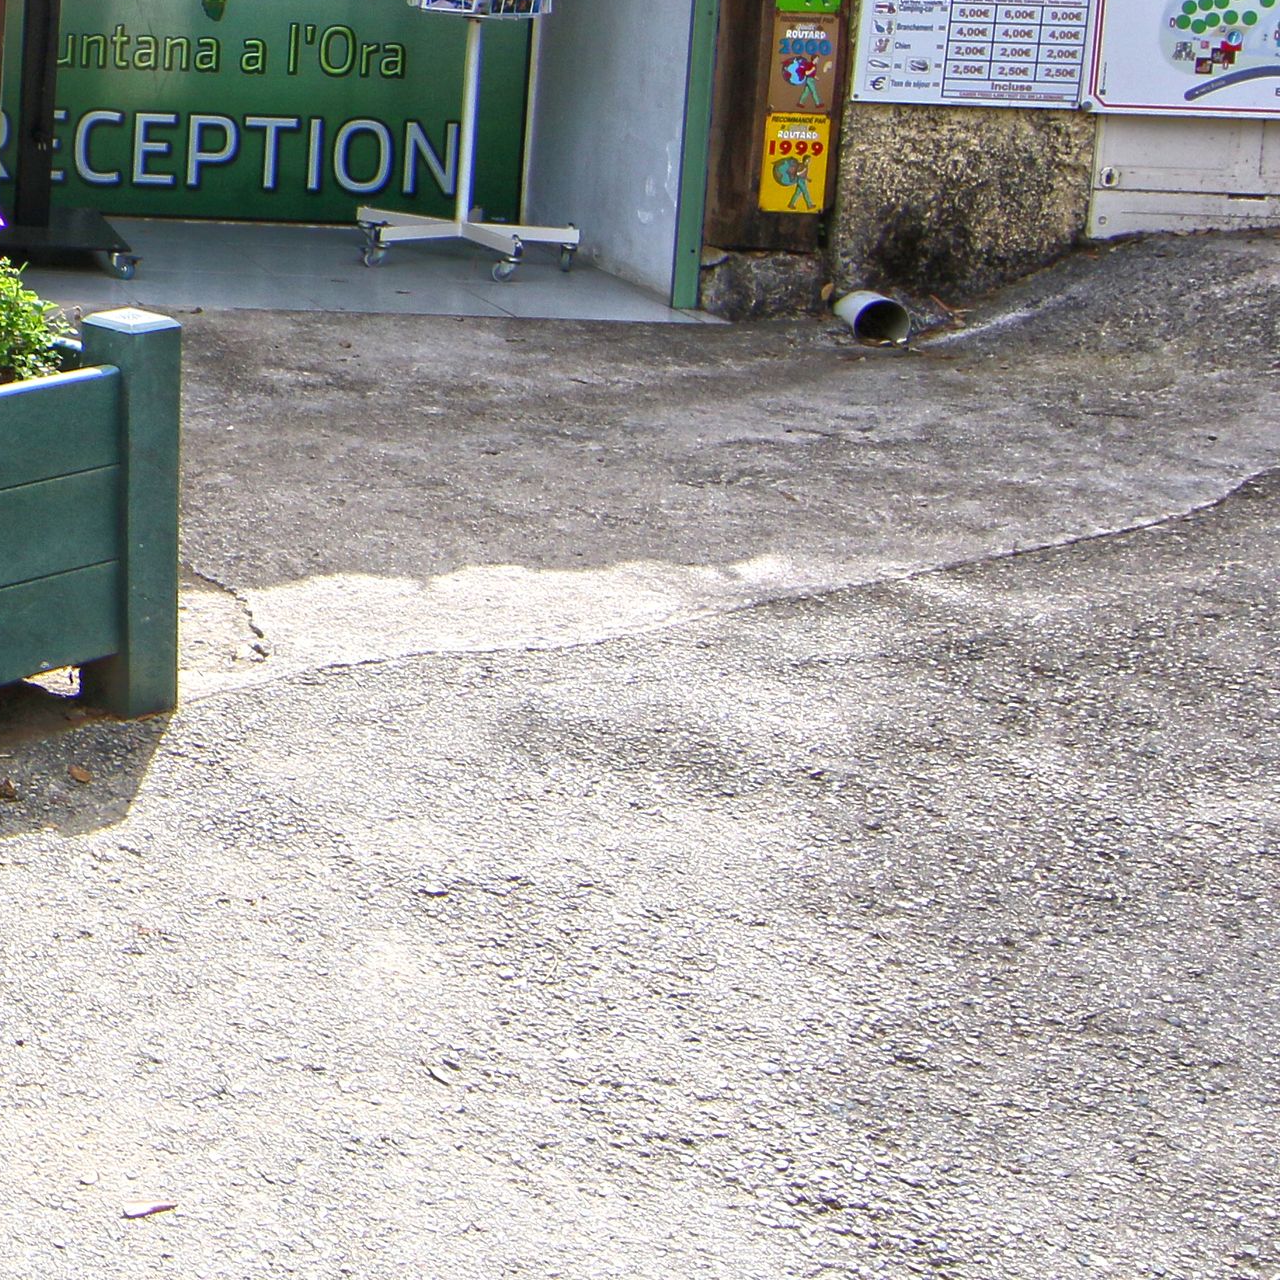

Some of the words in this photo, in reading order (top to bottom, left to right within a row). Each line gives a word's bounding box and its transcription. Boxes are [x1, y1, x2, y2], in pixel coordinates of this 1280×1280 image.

[786, 29, 826, 40] ROUTARD
[57, 23, 220, 73] untana
[241, 38, 266, 74] a
[287, 23, 407, 79] l'Ora
[779, 40, 832, 55] 2000
[991, 82, 1032, 91] Incluse
[777, 129, 818, 140] ROUTARD
[0, 109, 460, 197] CEPTION
[769, 140, 824, 156] 1999
